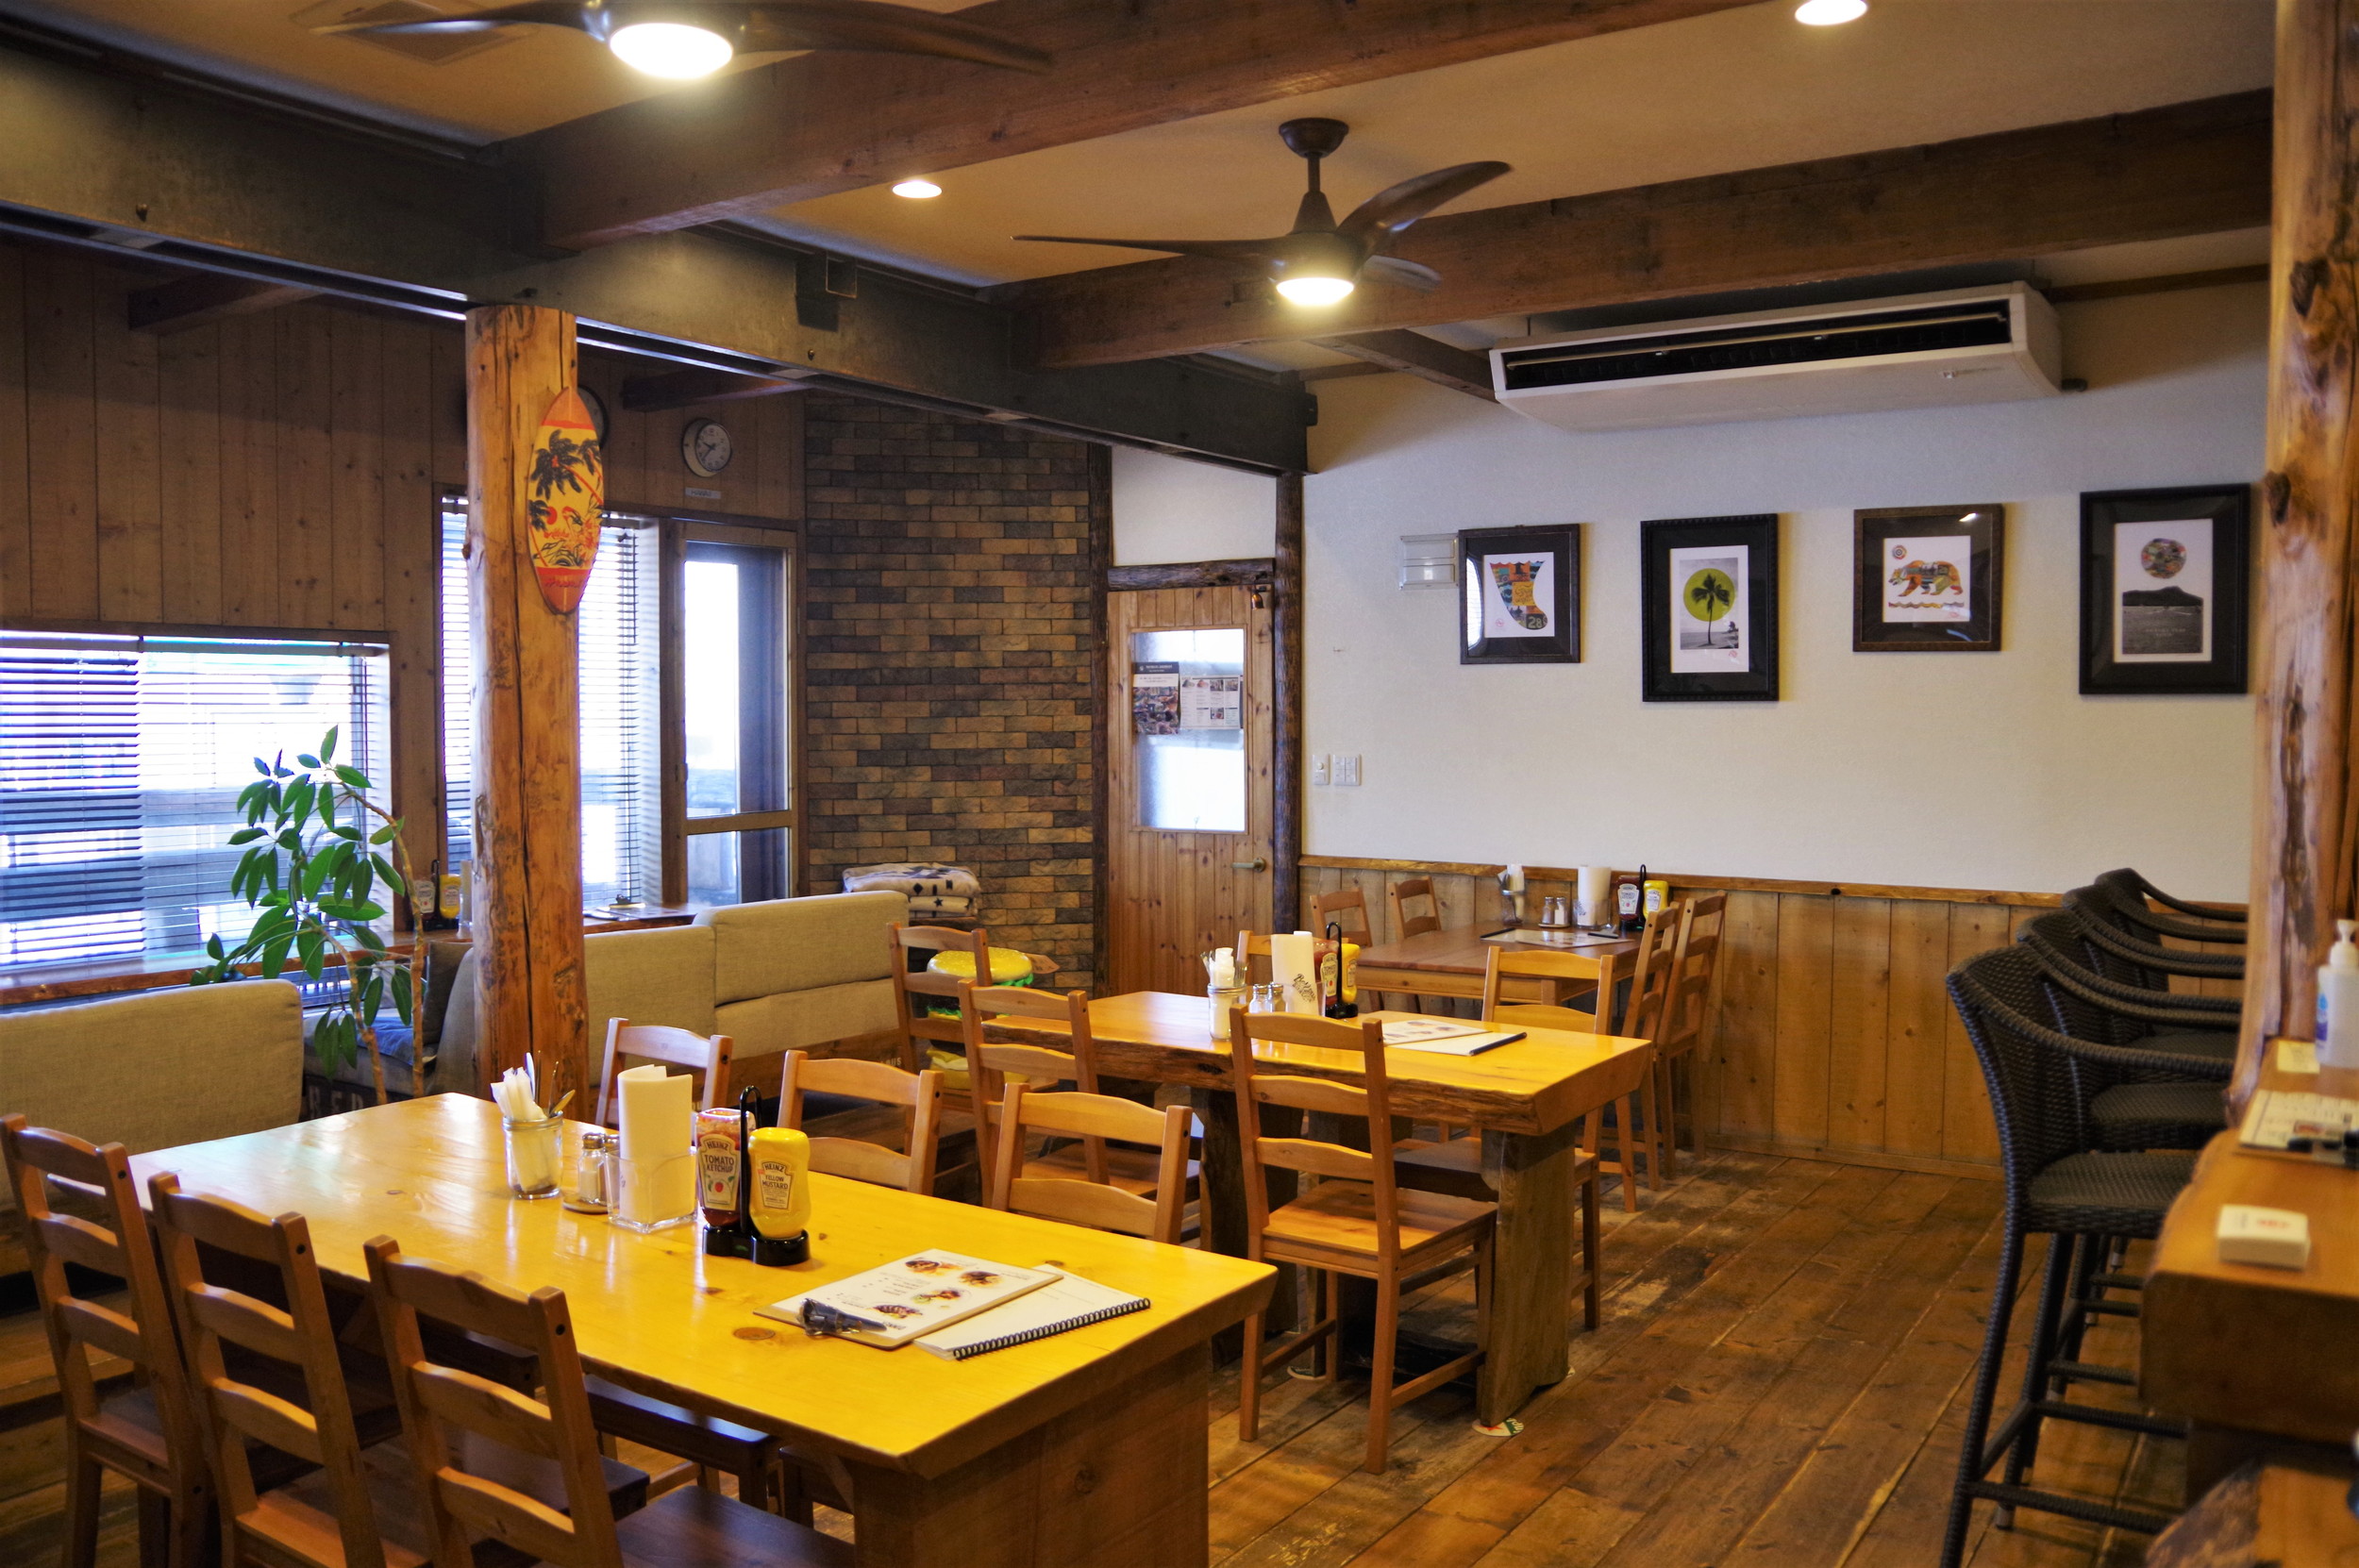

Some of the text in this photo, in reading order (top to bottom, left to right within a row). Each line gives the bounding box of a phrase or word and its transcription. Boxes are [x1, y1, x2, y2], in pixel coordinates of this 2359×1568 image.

[1528, 616, 1543, 629] 28
[707, 1141, 729, 1151] HEINZ
[704, 1154, 735, 1166] TOMATO
[706, 1163, 734, 1174] KETCHUP
[764, 1162, 785, 1173] HEINZ
[761, 1179, 789, 1190] MUSTARD
